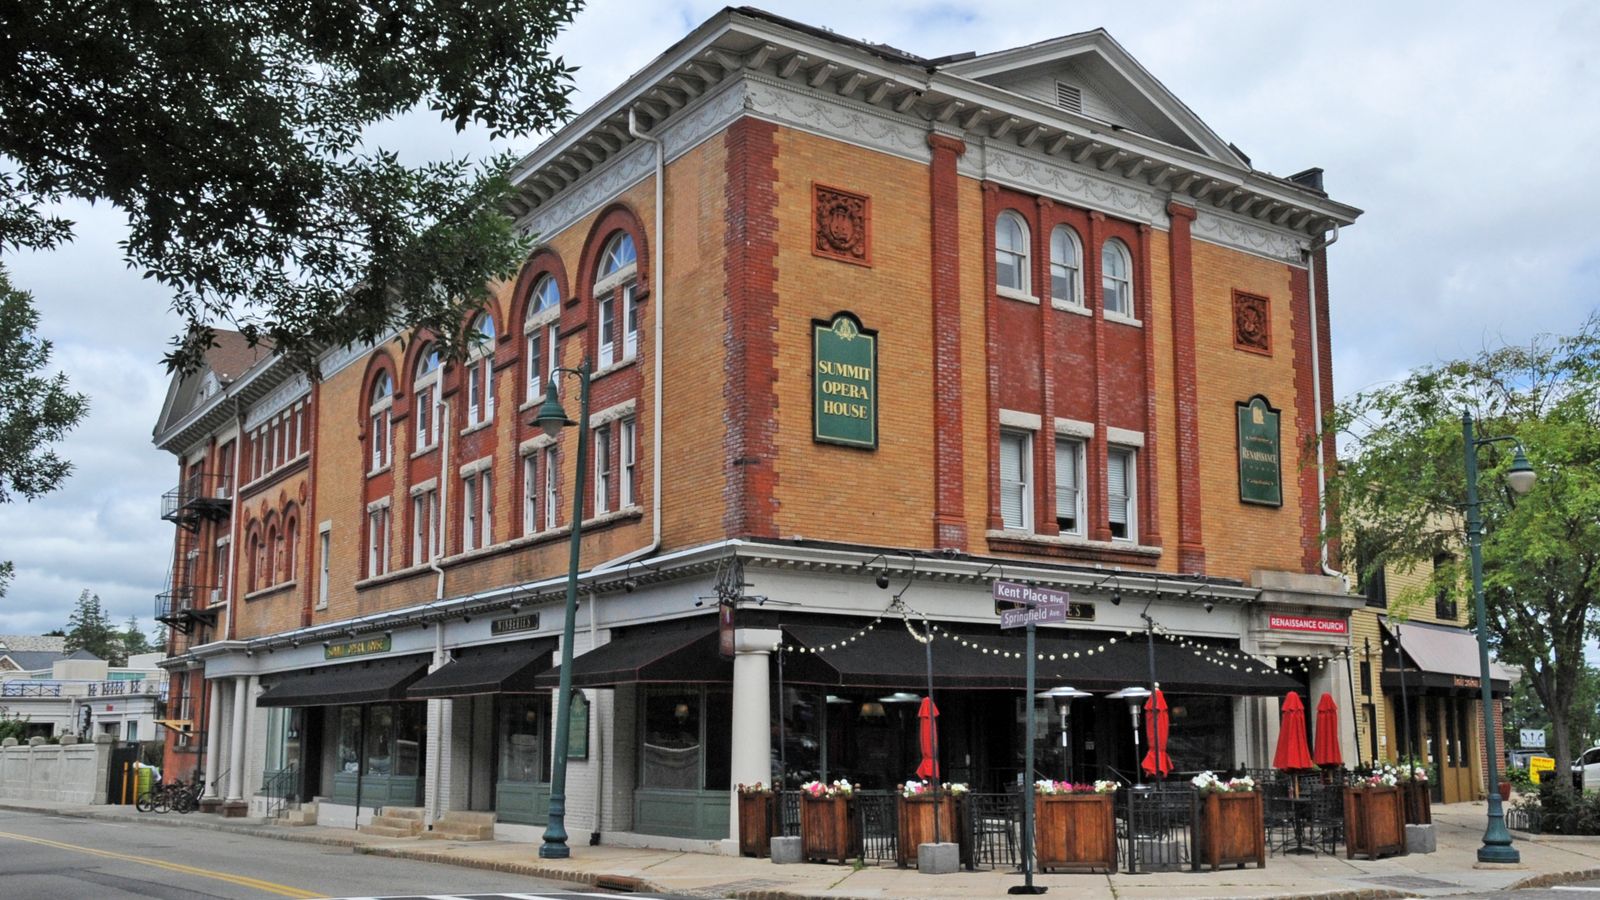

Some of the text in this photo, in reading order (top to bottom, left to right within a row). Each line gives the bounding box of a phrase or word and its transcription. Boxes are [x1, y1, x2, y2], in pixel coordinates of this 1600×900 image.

[819, 360, 871, 380] SUMMIT
[822, 380, 869, 399] OPERA
[823, 400, 868, 419] HOUSE
[998, 585, 1020, 599] Kent
[1023, 588, 1048, 603] Place
[1004, 608, 1047, 625] Springfield
[1271, 618, 1344, 630] RENAISSANCE CHURCH
